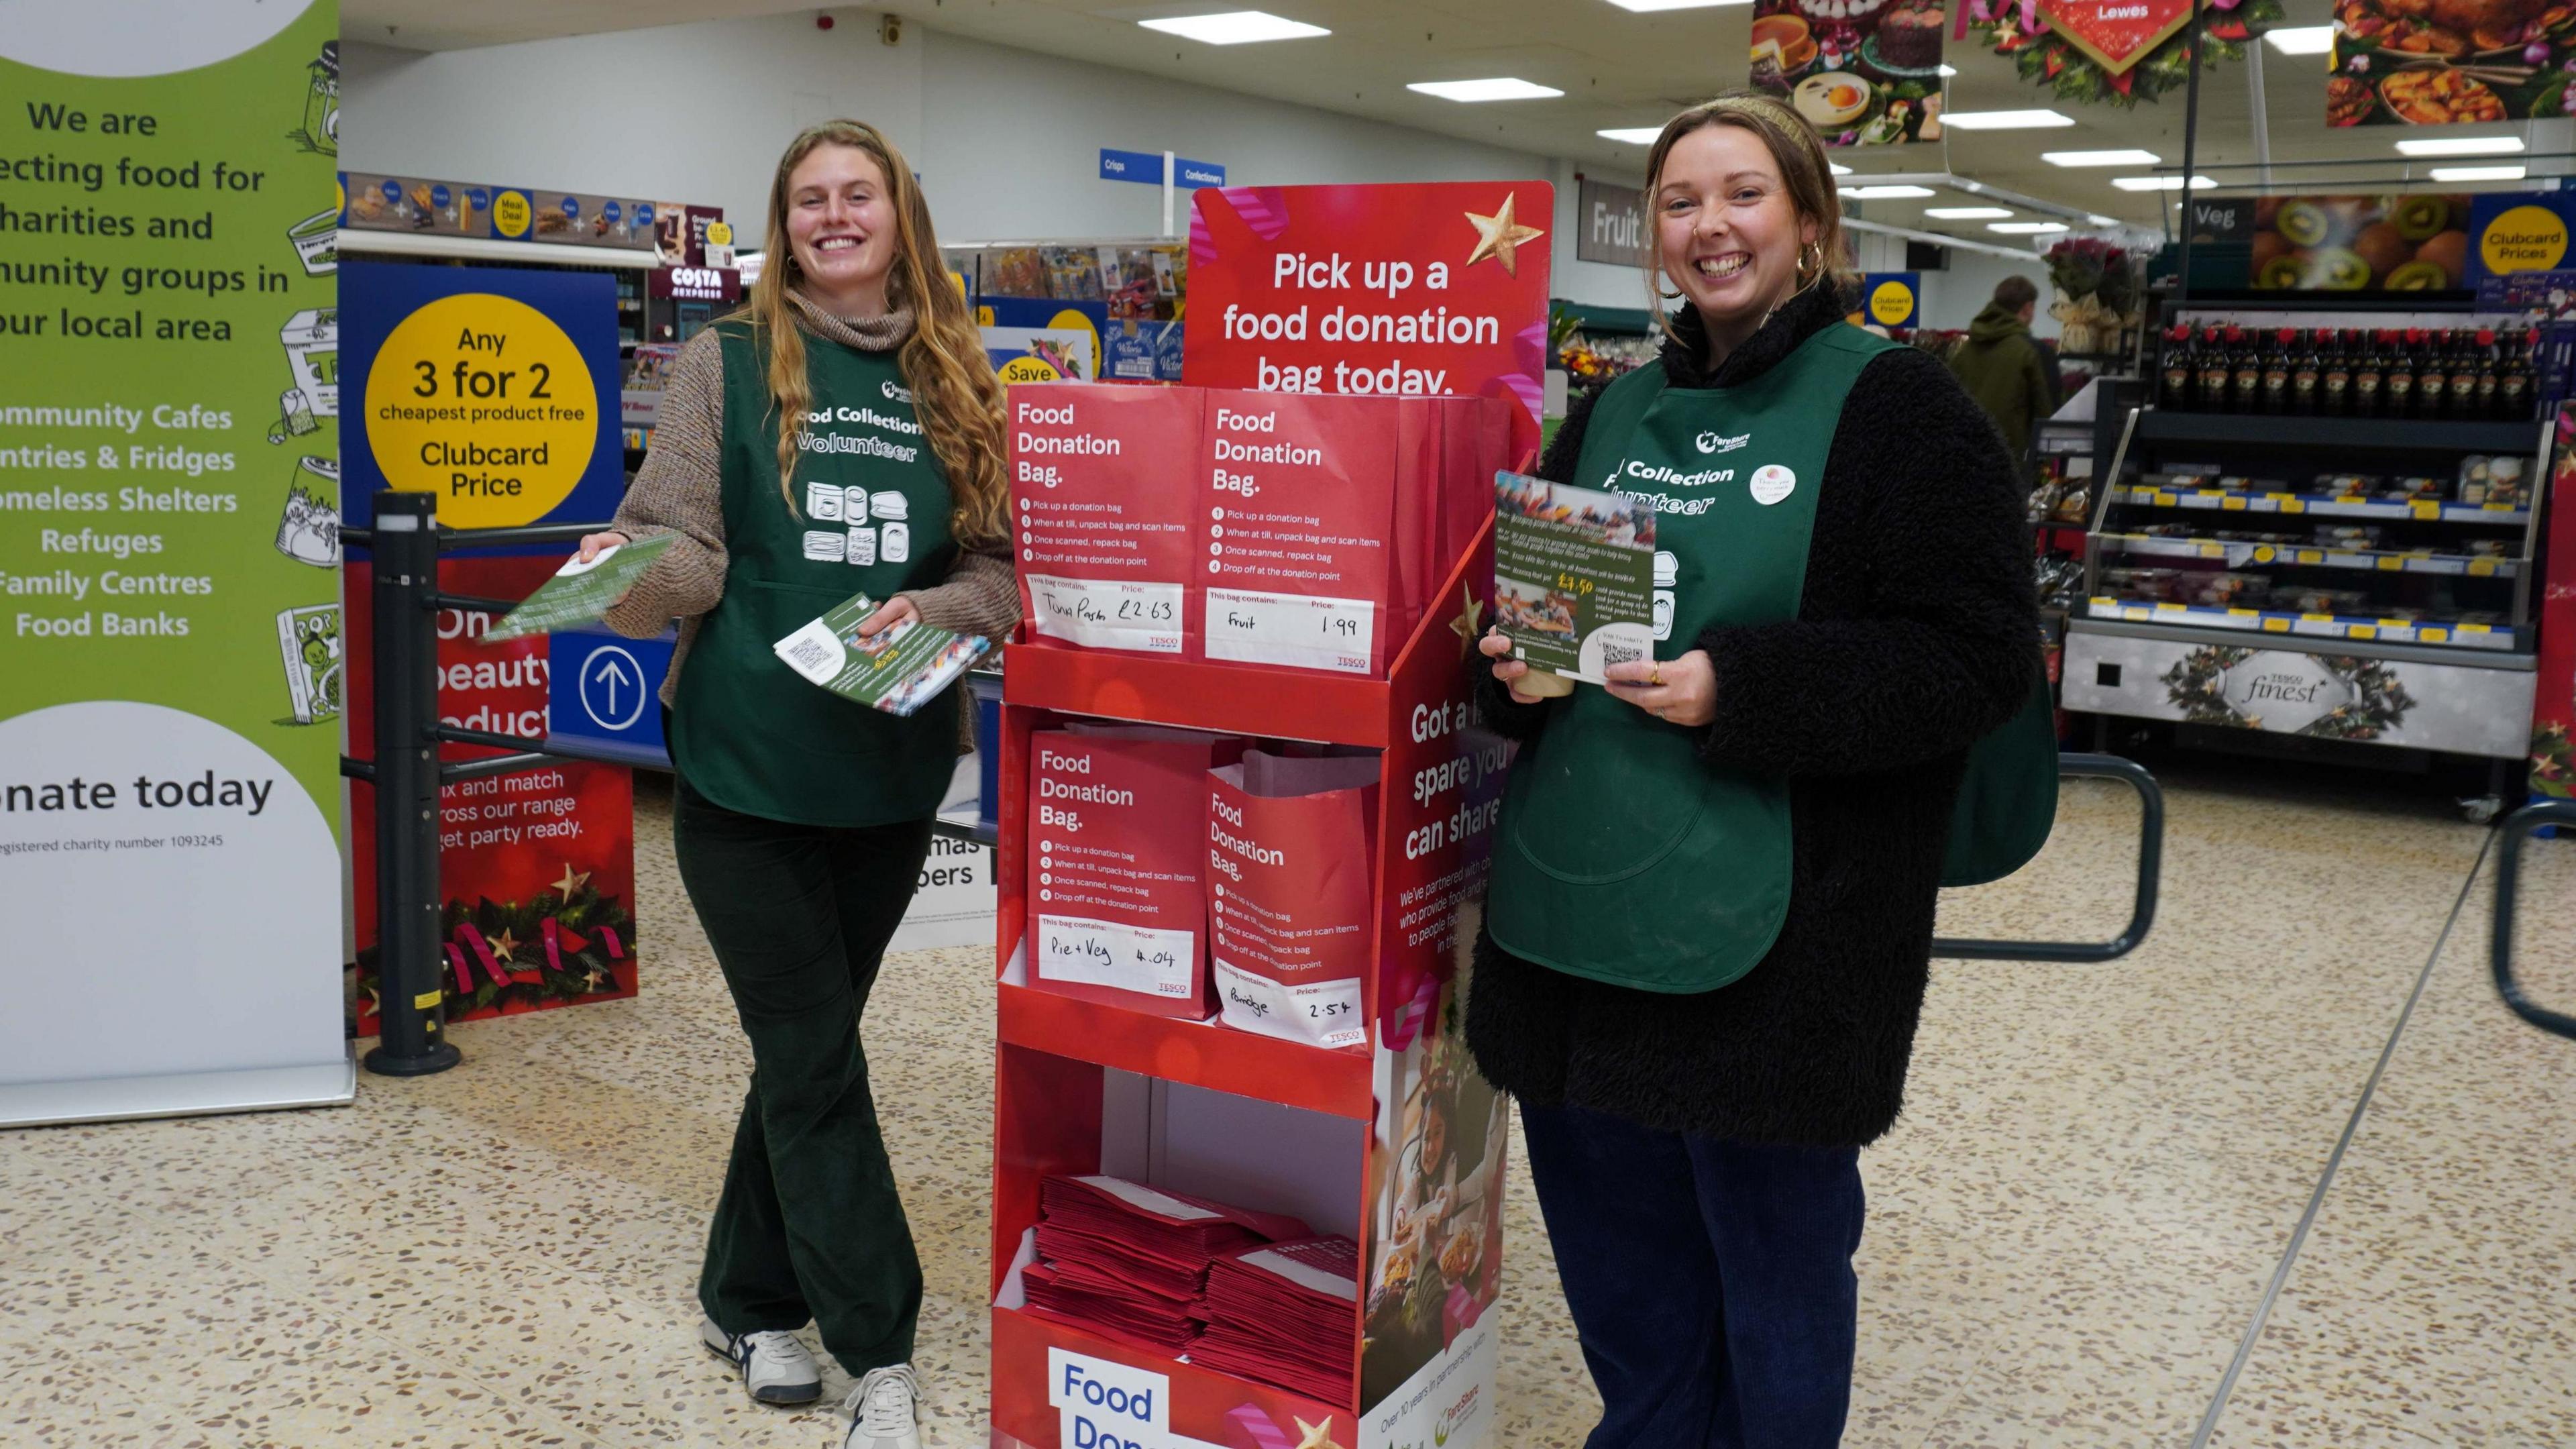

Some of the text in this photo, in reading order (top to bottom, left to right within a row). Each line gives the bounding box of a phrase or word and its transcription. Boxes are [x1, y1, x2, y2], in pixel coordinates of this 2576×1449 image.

[2098, 5, 2148, 21] Lewes
[28, 101, 156, 136] We are
[117, 158, 199, 189] food
[213, 162, 265, 191] for
[1105, 159, 1125, 172] Crisps
[1185, 169, 1222, 185] Confectionery
[502, 199, 523, 209] Meal
[502, 211, 522, 221] Deal
[2196, 205, 2235, 229] Veg
[0, 205, 212, 239] harities and
[1593, 202, 1640, 248] Fruit
[2489, 231, 2561, 248] Clubcard
[2499, 246, 2548, 260] Prices
[121, 268, 245, 297] groups
[258, 265, 288, 292] in
[672, 268, 722, 289] COSTA
[1275, 253, 1448, 299] Pick up a
[680, 287, 722, 299] EXPRESS
[62, 308, 231, 340] local area
[1224, 304, 1499, 344] food donation
[458, 328, 506, 356] Any
[413, 360, 551, 398] 3 for 2
[1009, 365, 1051, 381] Save
[1258, 356, 1322, 394] bag
[153, 405, 232, 429] Cafes
[380, 405, 584, 425] cheapest product free
[837, 407, 922, 435] Collection
[1018, 402, 1073, 425] Food
[1217, 409, 1275, 433] Food
[421, 441, 549, 466] Clubcard
[796, 431, 917, 463] Volunteer
[1018, 432, 1120, 455] Donation
[1214, 439, 1321, 466] Donation
[1, 445, 235, 477] ntries & Fridges
[1627, 461, 1734, 486] Collection
[451, 472, 522, 496] Price
[1018, 461, 1063, 488] Bag.
[1213, 468, 1260, 497] Bag.
[119, 487, 237, 512] Shelters
[1228, 510, 1244, 520] Pick
[1246, 513, 1256, 522] up
[1266, 513, 1302, 524] donation
[1305, 516, 1320, 526] bag
[42, 529, 162, 559] Refuges
[1227, 529, 1249, 537] When
[1275, 533, 1303, 543] unpack
[1305, 535, 1320, 544] bag
[1322, 536, 1336, 545] and
[1359, 538, 1380, 547] items
[1226, 546, 1332, 564] Once scanned, repack bag
[101, 571, 212, 594] Centres
[1224, 564, 1340, 581] Drop off at the donation point
[1210, 592, 1334, 609] This bag contains: Price:
[16, 612, 189, 637] Food Banks
[1228, 612, 1356, 636] Fruit 1.99
[1338, 656, 1365, 666] TESCO
[2241, 676, 2318, 704] finest
[2271, 673, 2304, 682] TESCO
[1411, 699, 1466, 743] Got a
[1041, 750, 1090, 774] Food
[1413, 742, 1507, 808] spare you
[0, 769, 273, 816] nate today
[462, 771, 564, 796] and match
[1040, 777, 1133, 806] Donation
[484, 797, 576, 818] our range
[1040, 805, 1083, 832] Bag.
[1212, 792, 1242, 828] Food
[470, 818, 583, 849] party ready.
[1406, 798, 1500, 860] can share
[64, 837, 110, 851] charity
[115, 836, 165, 849] number
[171, 835, 223, 847] 1093245
[1211, 821, 1284, 866] Donation
[1211, 849, 1242, 882] Bag.
[1400, 867, 1463, 907] We've partnered
[1399, 879, 1481, 929] who provide food and
[1409, 918, 1446, 947] to people
[1052, 937, 1072, 955] Pie
[1085, 938, 1111, 965] Veg
[1136, 949, 1175, 967] 4.04
[1310, 1002, 1351, 1018] 2.54
[1065, 1363, 1152, 1423] Food
[1381, 1345, 1472, 1433] Over 10 years in partnership
